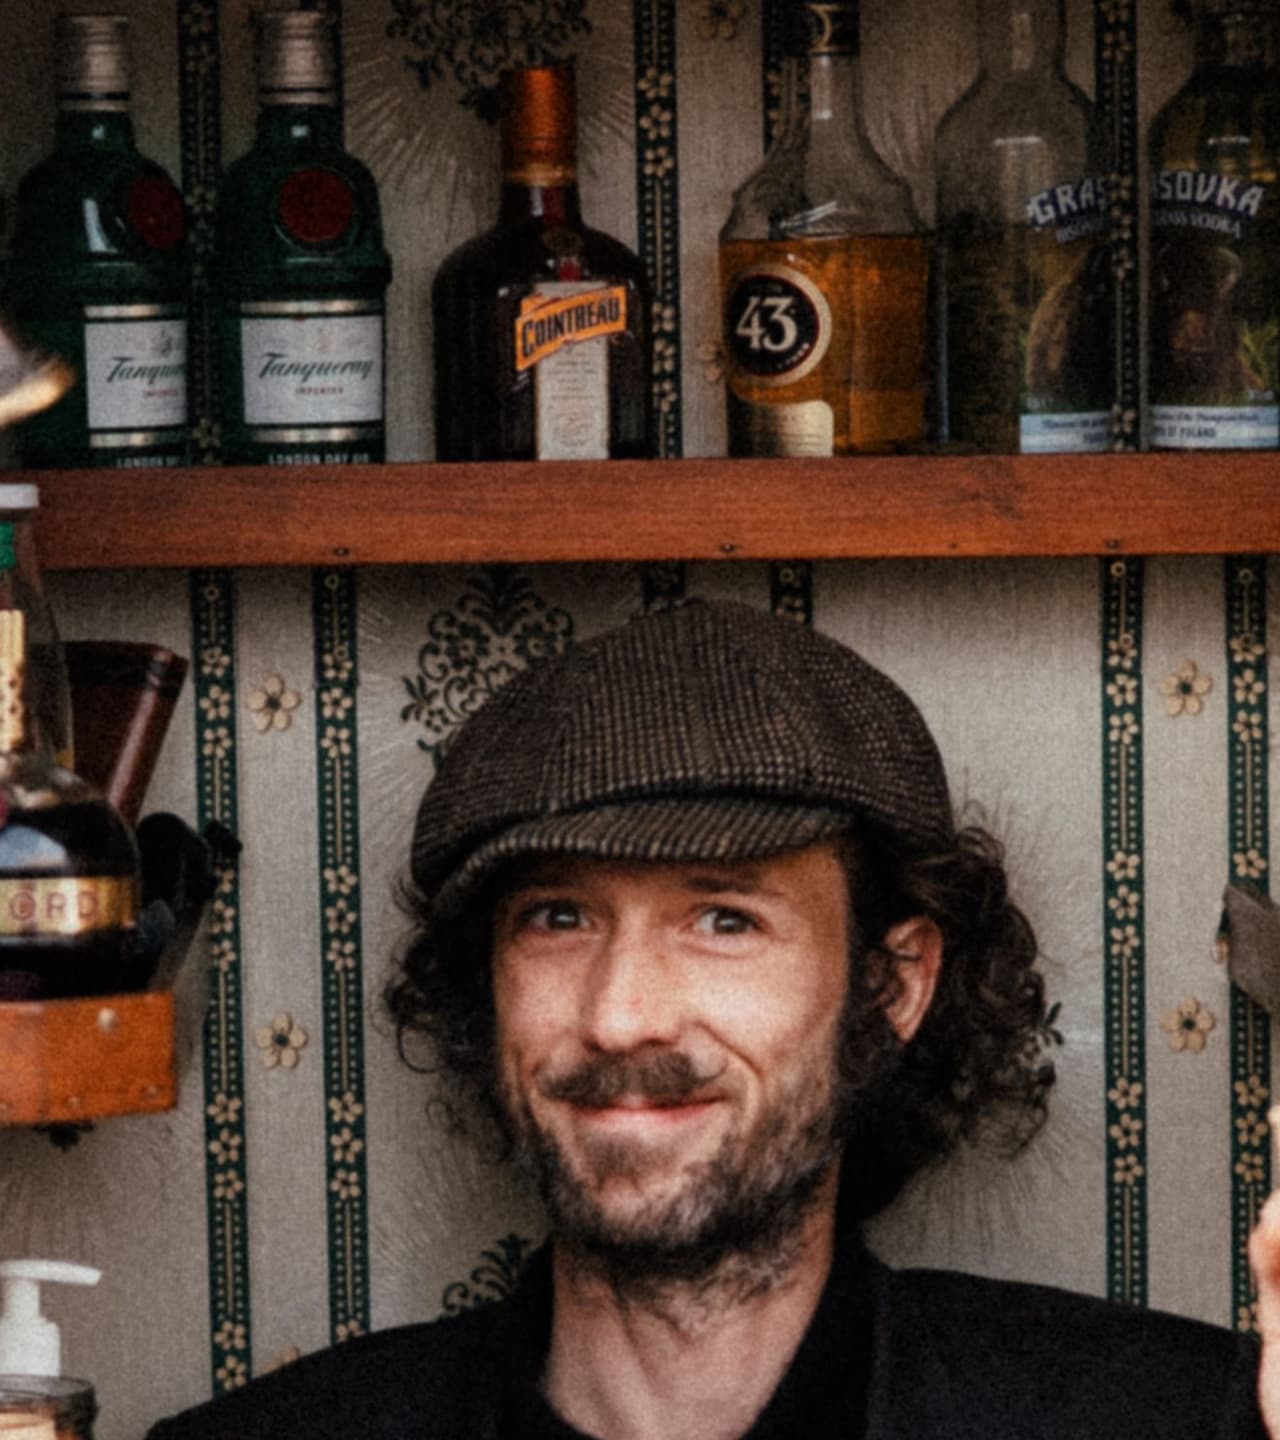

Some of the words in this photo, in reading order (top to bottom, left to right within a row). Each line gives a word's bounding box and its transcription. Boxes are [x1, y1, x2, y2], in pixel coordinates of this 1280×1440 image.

[521, 298, 619, 358] COINTREAU
[735, 296, 798, 352] 43
[258, 352, 374, 383] Tanqueray
